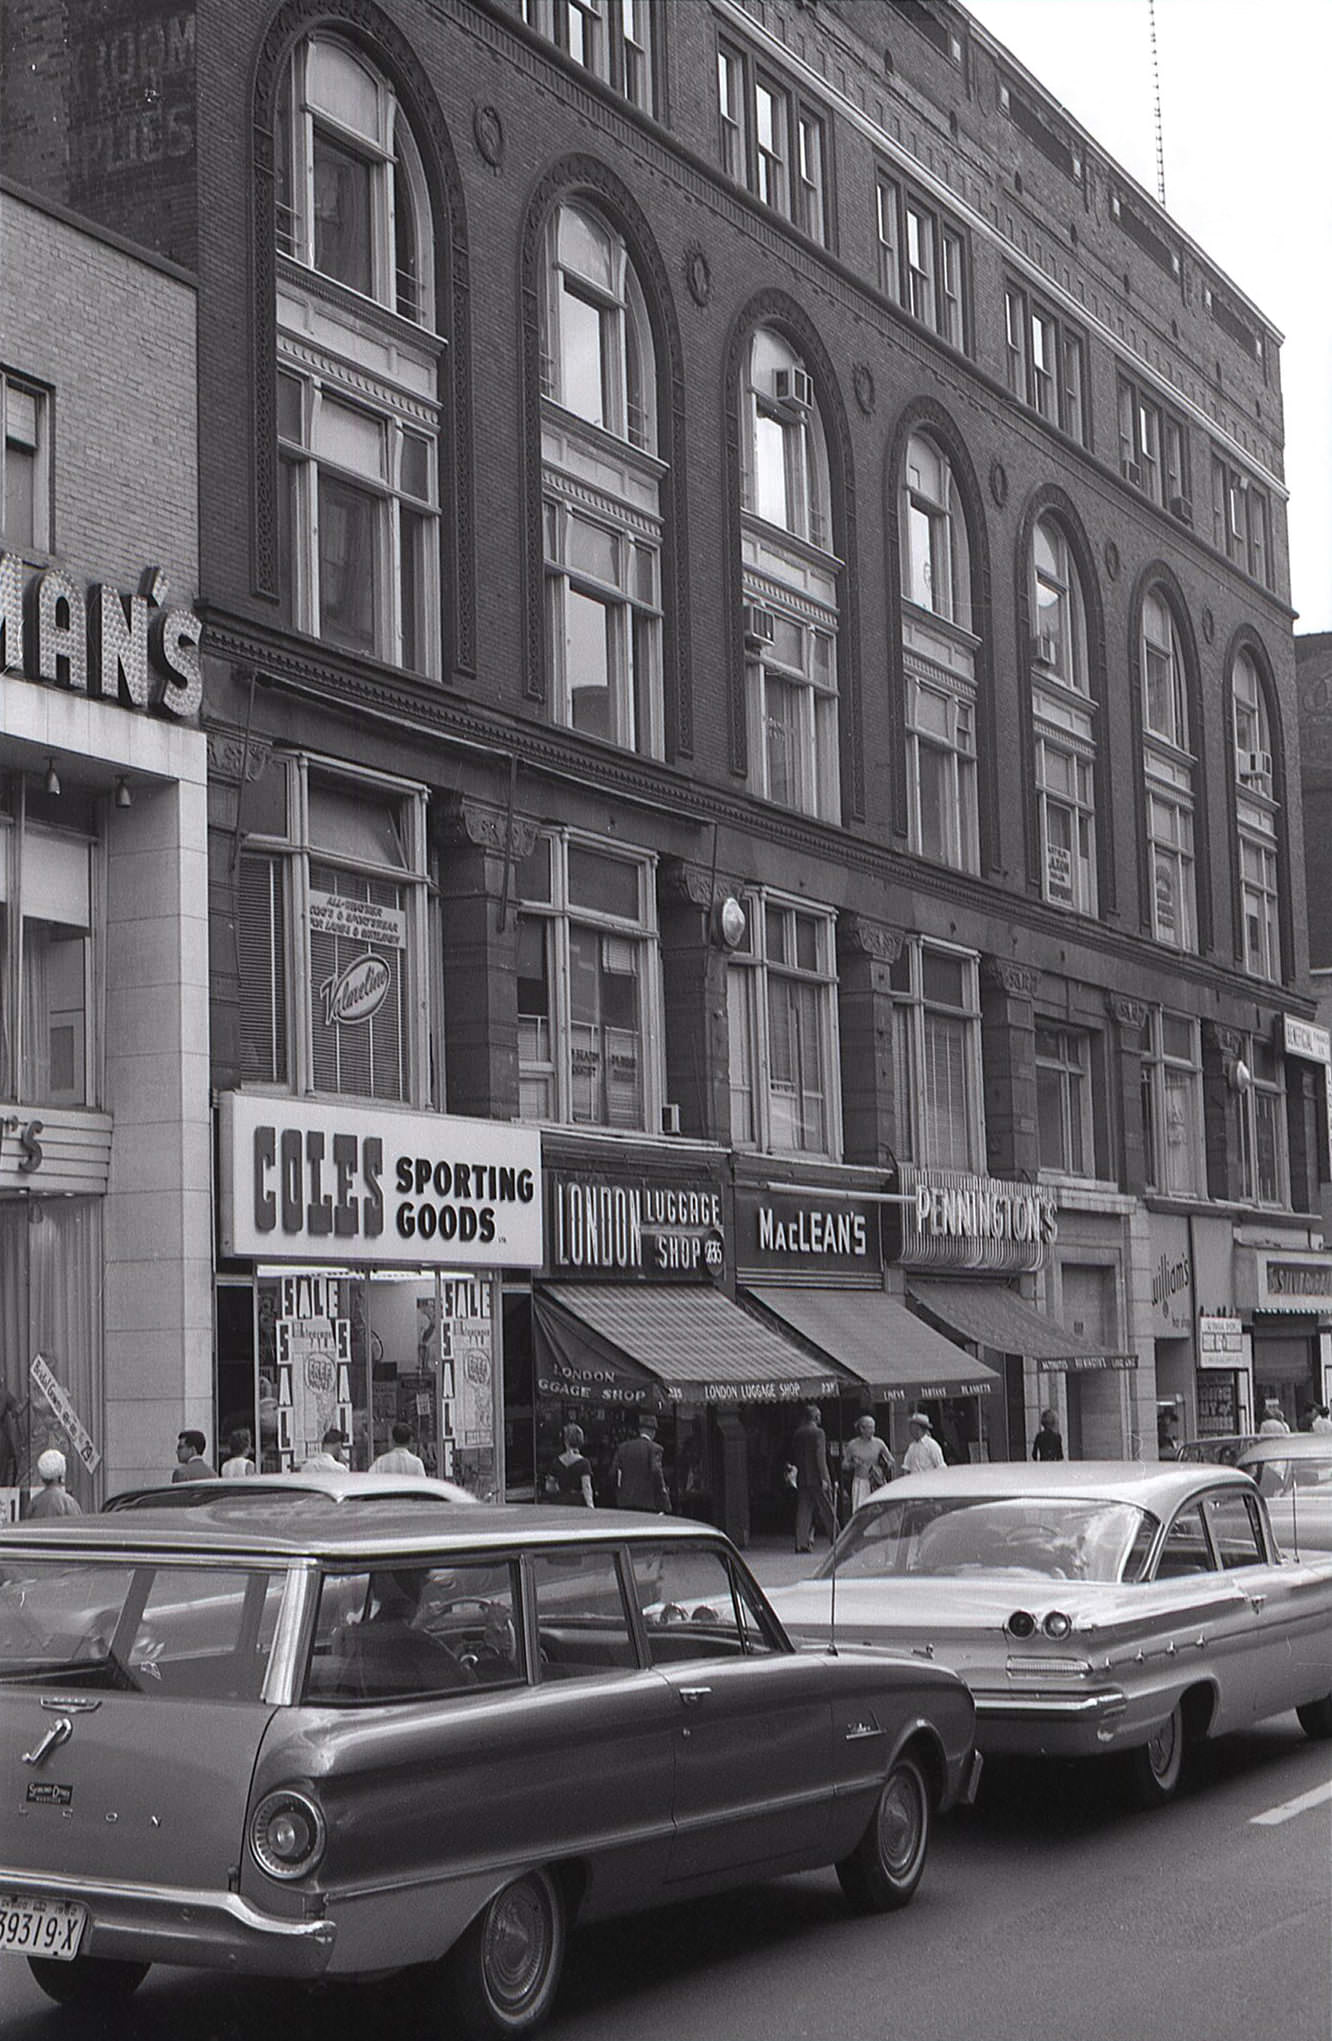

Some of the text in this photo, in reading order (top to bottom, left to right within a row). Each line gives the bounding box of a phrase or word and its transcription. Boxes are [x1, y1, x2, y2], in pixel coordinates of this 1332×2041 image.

[254, 1126, 383, 1238] COLES
[396, 1157, 534, 1203] SPORTING
[396, 1202, 496, 1244] GOODS
[556, 1183, 643, 1267] LONDON
[647, 1189, 720, 1225] LUGGAGE
[916, 1183, 1058, 1246] PENNINGTON'S
[658, 1236, 701, 1269] SHOP
[283, 1278, 338, 1319] SALE
[443, 1281, 492, 1319] SALE
[554, 1363, 616, 1383] LONDON
[704, 1384, 738, 1400] LONDON
[740, 1384, 776, 1399] LUGGAGE
[779, 1381, 800, 1396] SHOP
[601, 1388, 646, 1401] SHOP
